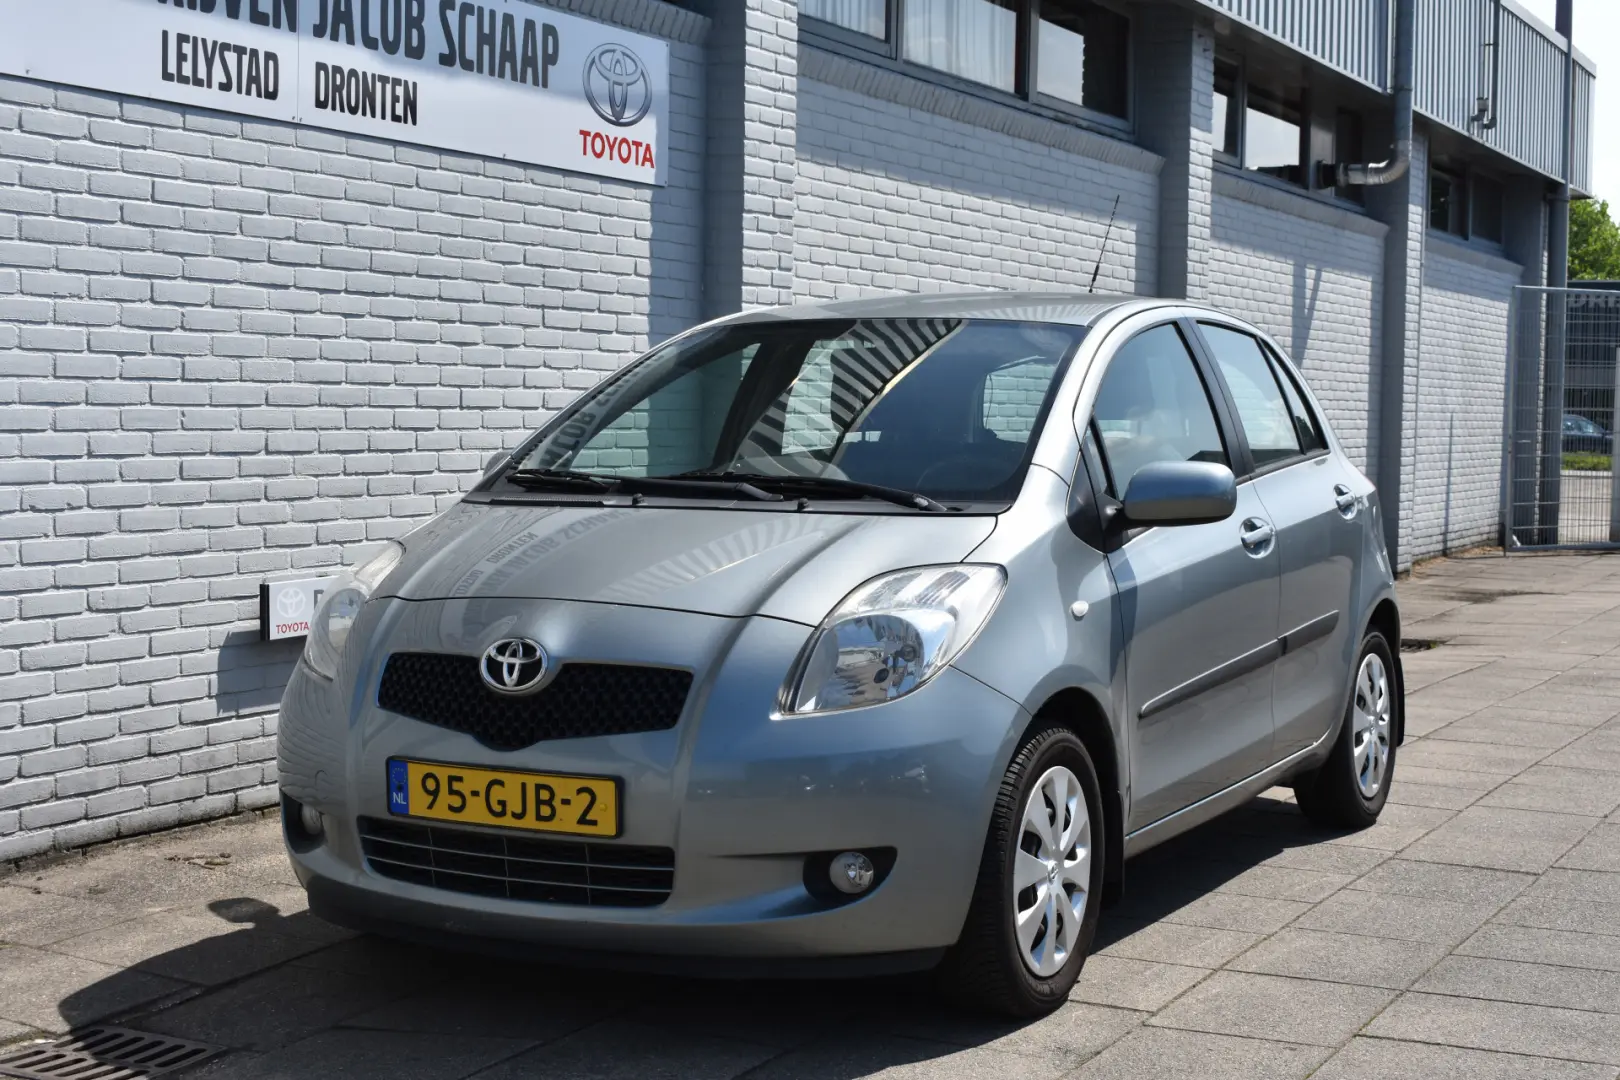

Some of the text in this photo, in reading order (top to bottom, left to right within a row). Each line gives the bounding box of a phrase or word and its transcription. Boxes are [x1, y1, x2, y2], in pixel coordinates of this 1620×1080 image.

[438, 0, 560, 89] SCHAAP
[161, 29, 418, 126] LELYSTAD DRONTEN
[579, 129, 655, 169] TOYOTA
[275, 621, 310, 634] TOYOTA
[392, 772, 599, 827] NL 95-GJB-2
